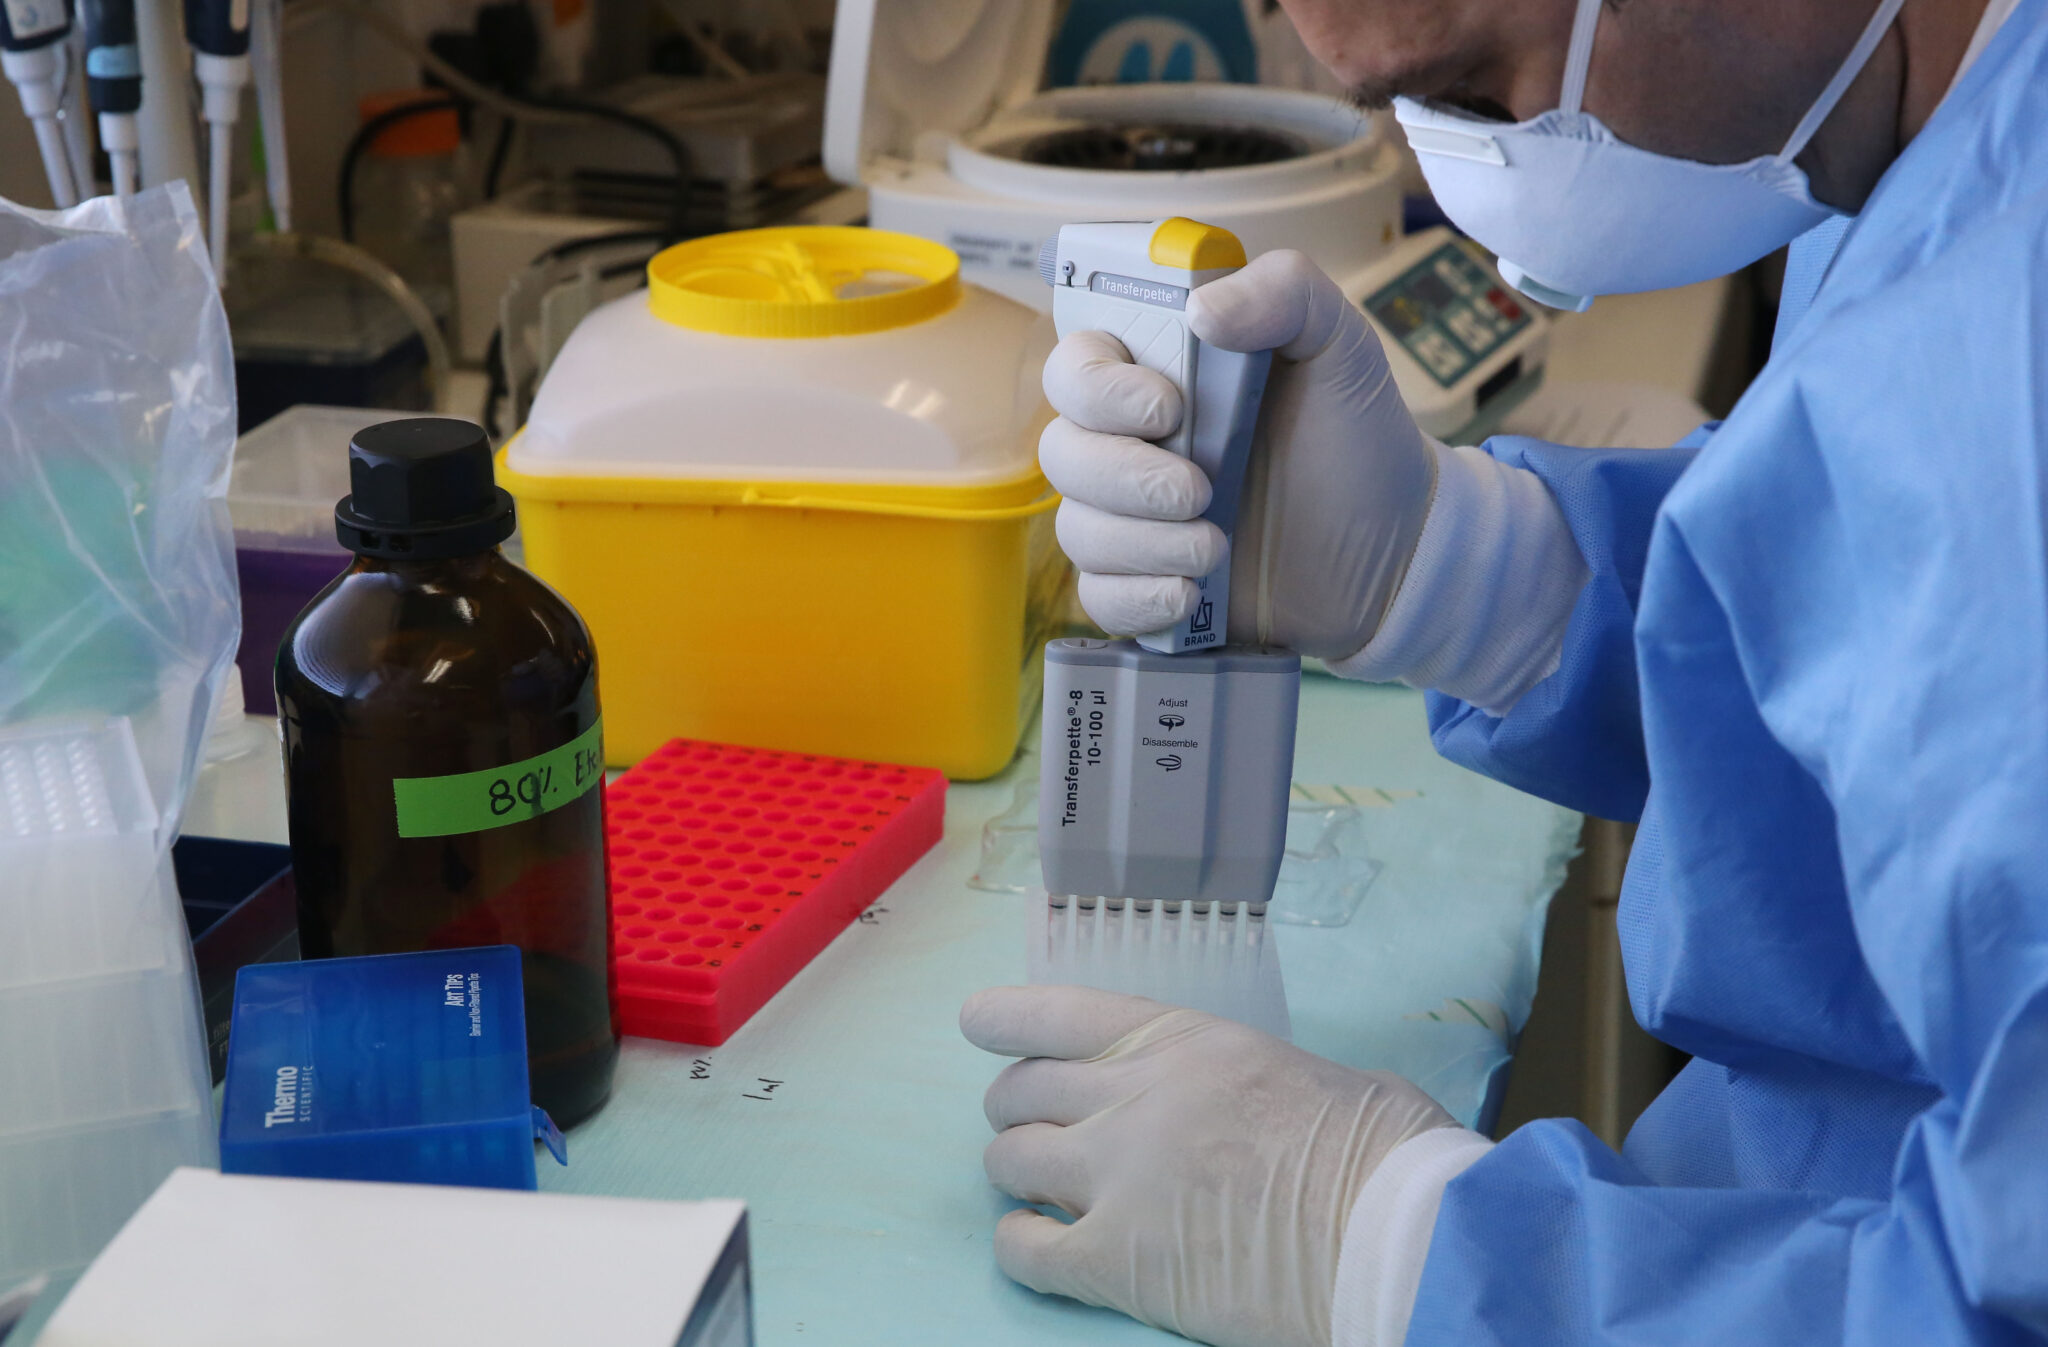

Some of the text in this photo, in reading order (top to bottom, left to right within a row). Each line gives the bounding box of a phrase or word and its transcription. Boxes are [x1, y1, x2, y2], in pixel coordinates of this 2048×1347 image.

[1100, 276, 1178, 303] Transferpette®
[1184, 633, 1216, 646] BRAND
[1158, 697, 1188, 708] Adjust
[1087, 710, 1104, 766] 10-100
[1142, 737, 1199, 749] Disassemble
[264, 1066, 298, 1128] Thermo
[300, 1065, 313, 1122] SCIENTIFIC
